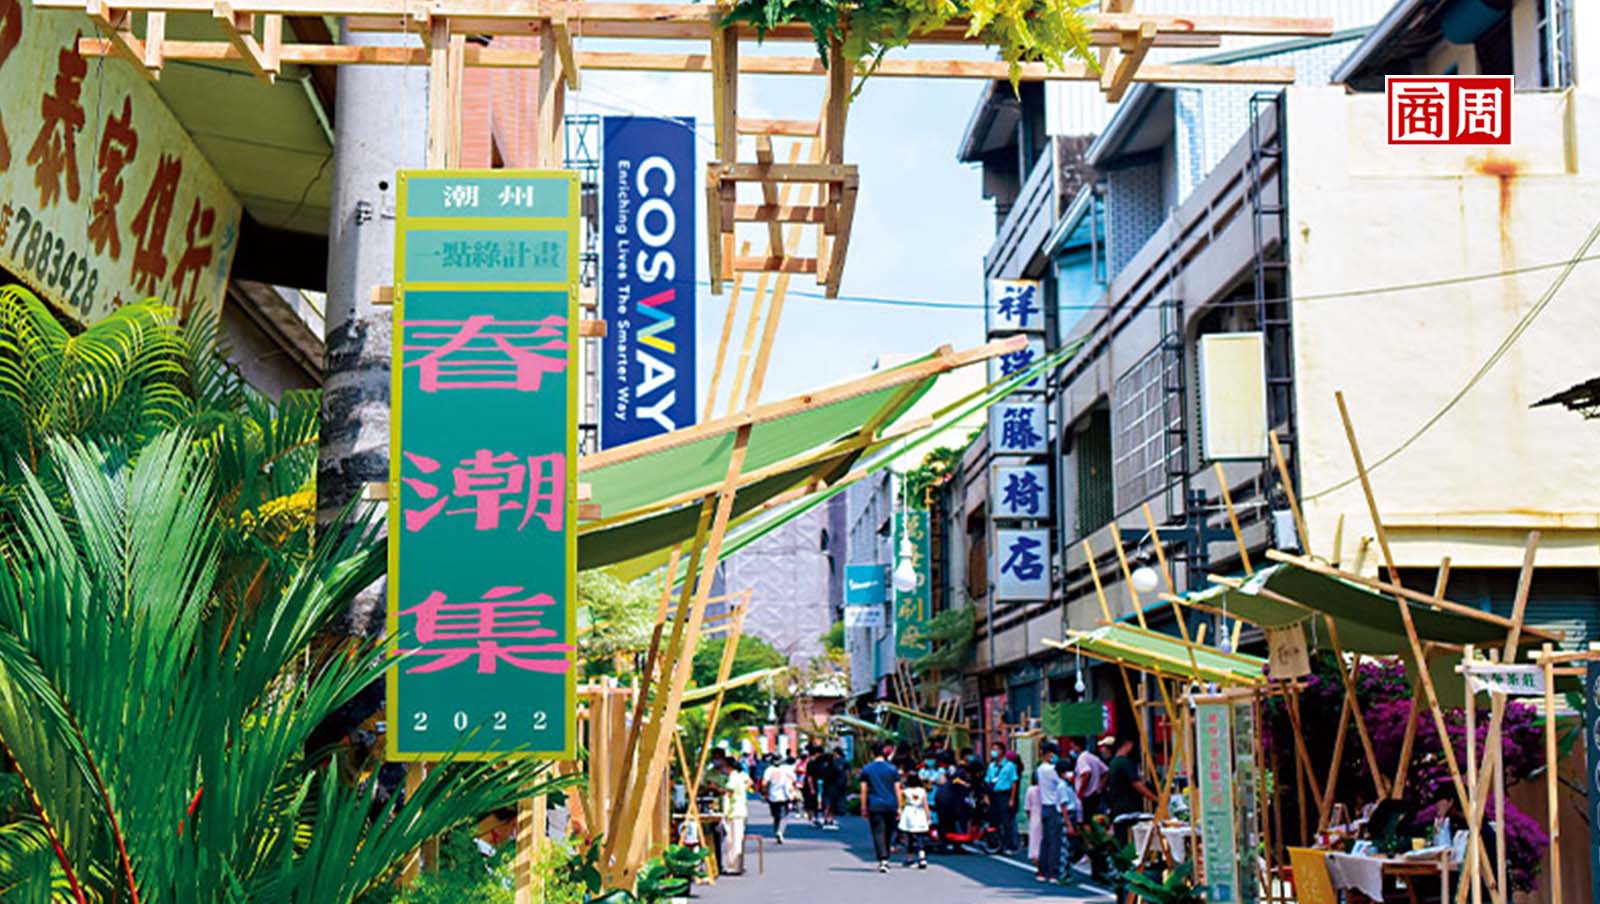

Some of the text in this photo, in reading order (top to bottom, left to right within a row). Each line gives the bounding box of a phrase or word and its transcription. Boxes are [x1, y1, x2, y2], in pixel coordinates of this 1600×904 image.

[0, 0, 216, 326] 泰家俱行
[10, 206, 98, 316] 7883428
[442, 184, 534, 208] 潮州
[614, 159, 630, 421] Enriching Lives The Smarter Way
[636, 156, 676, 432] COSWAY
[391, 314, 574, 675] 春潮集
[413, 711, 547, 731] 2022
